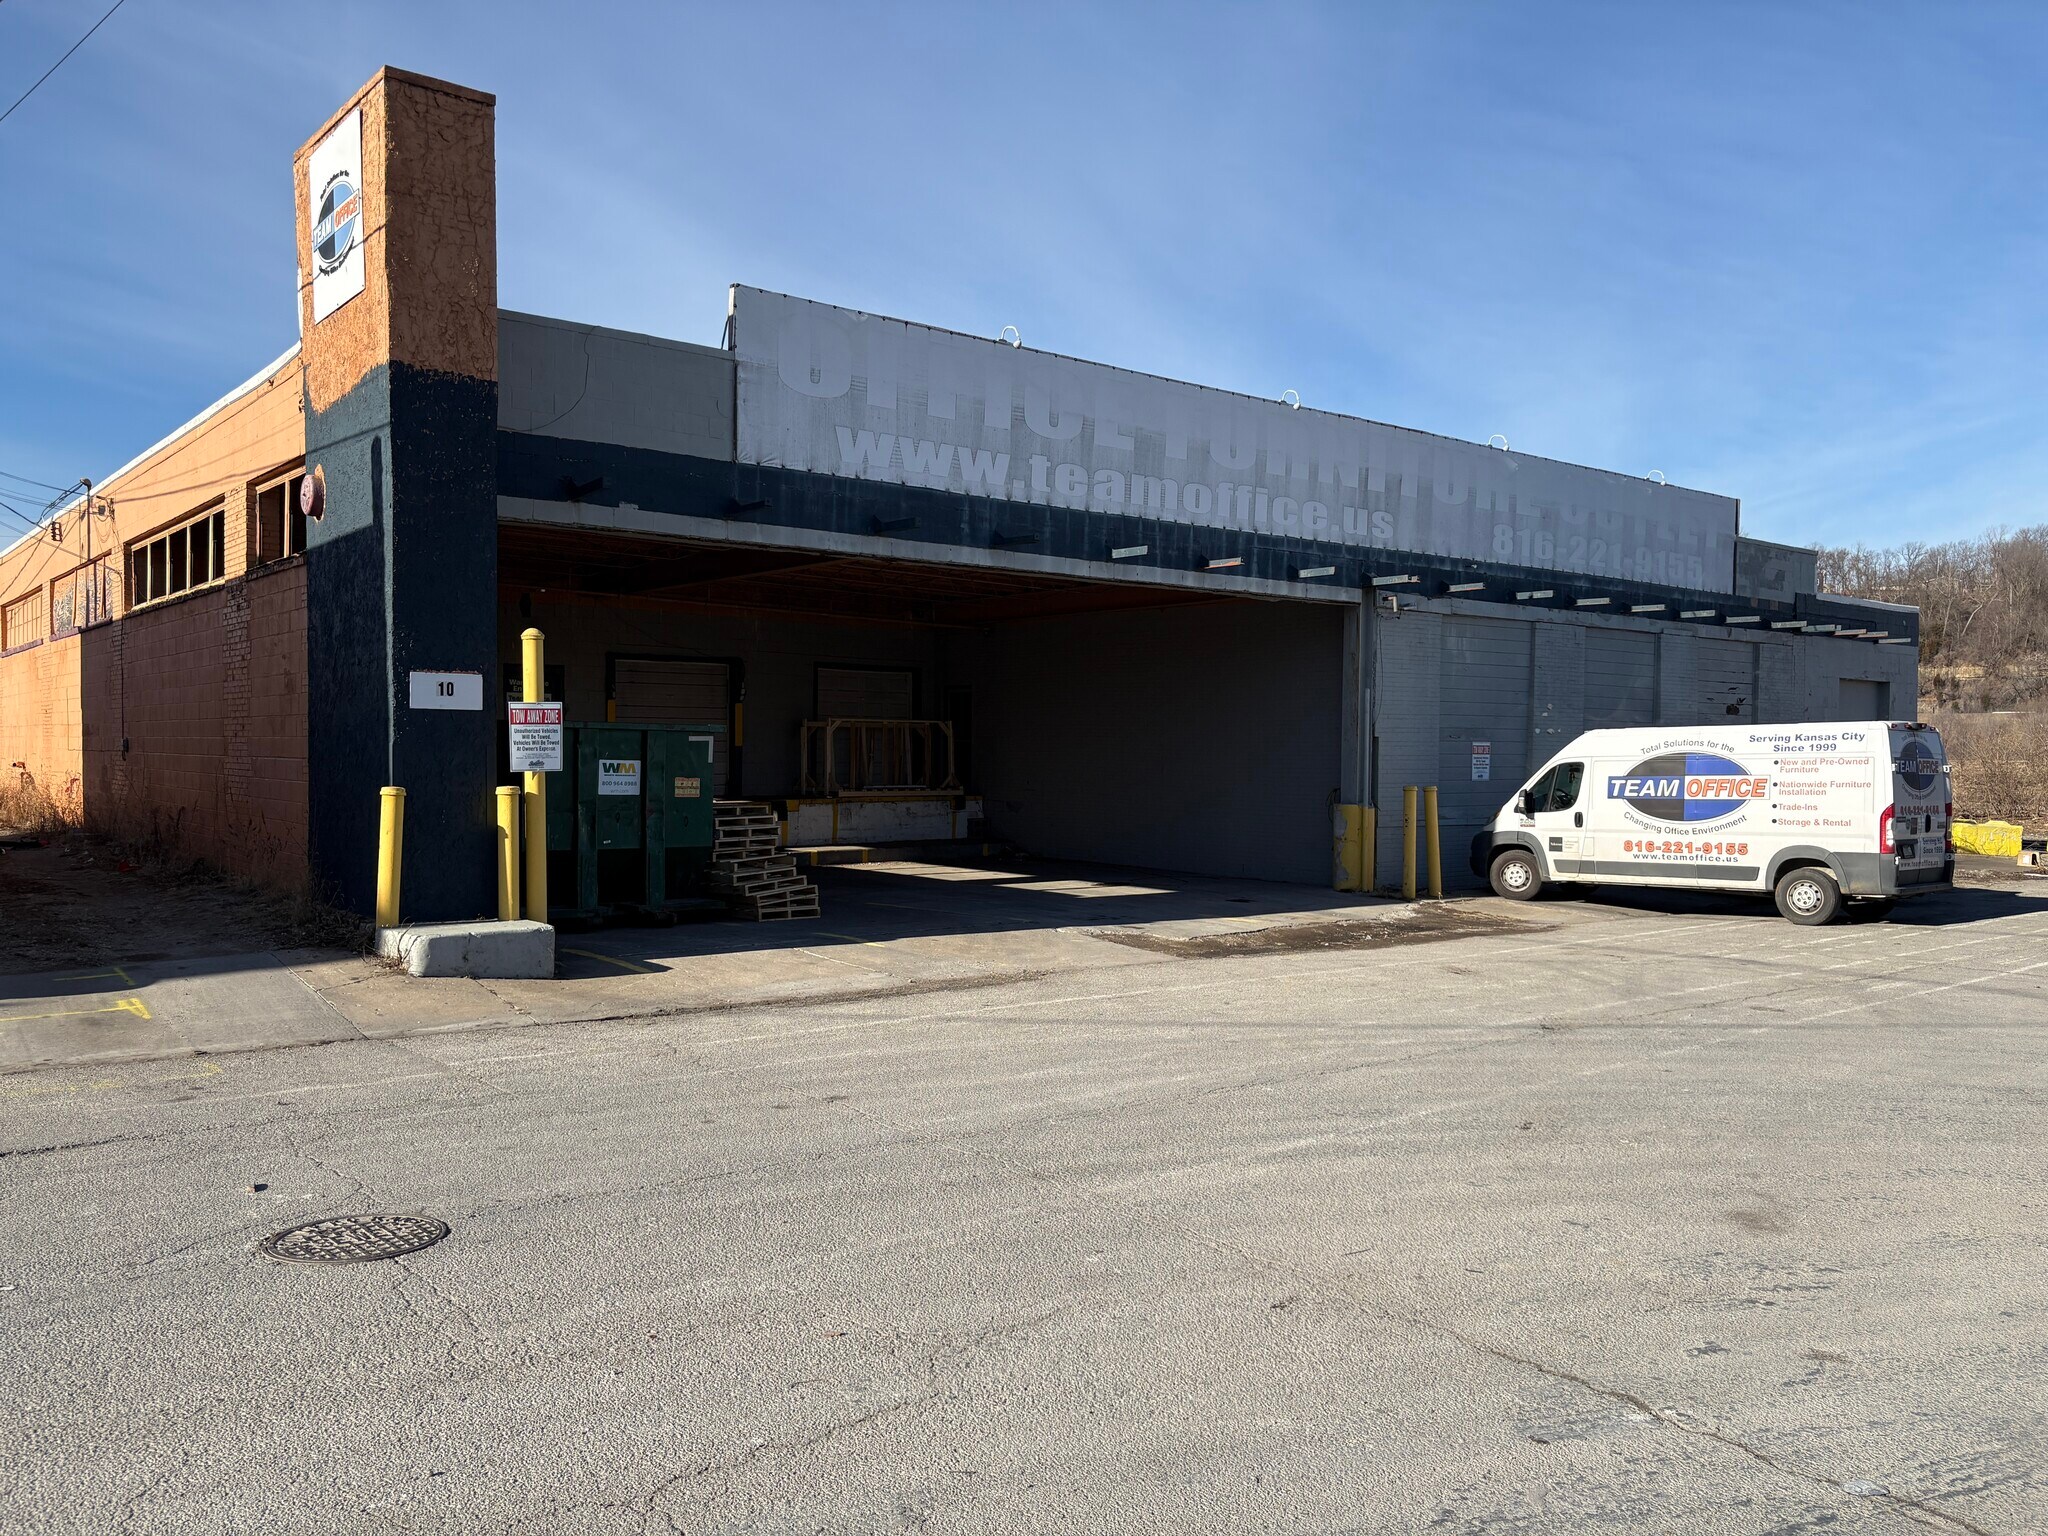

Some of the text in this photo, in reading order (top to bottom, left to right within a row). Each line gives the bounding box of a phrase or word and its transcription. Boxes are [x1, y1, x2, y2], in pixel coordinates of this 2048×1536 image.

[313, 193, 358, 248] TEAM OFFICE
[834, 425, 1394, 539] www.teamoffice.us
[438, 681, 454, 697] 10
[511, 709, 559, 724] TOW AWAY ZONE
[1749, 732, 1866, 744] Serving Kansas City
[1640, 738, 1735, 755] Total Solutions for the
[1773, 743, 1837, 752] Since 1999
[1780, 757, 1870, 766] New and Pre-Owned
[1895, 760, 1939, 774] TEAM OFFICE
[1610, 778, 1768, 798] TEAM OFFICE
[1779, 780, 1872, 789] Nationwide Furniture
[1778, 788, 1827, 796] Installation
[1778, 803, 1818, 811] Trade-Ins
[1623, 811, 1747, 836] Changing Office Environment
[1777, 818, 1811, 828] Storage
[1822, 819, 1852, 827] Rental
[1623, 840, 1749, 855] 816-221-9155
[1632, 853, 1739, 863] www.teamoffice.us
